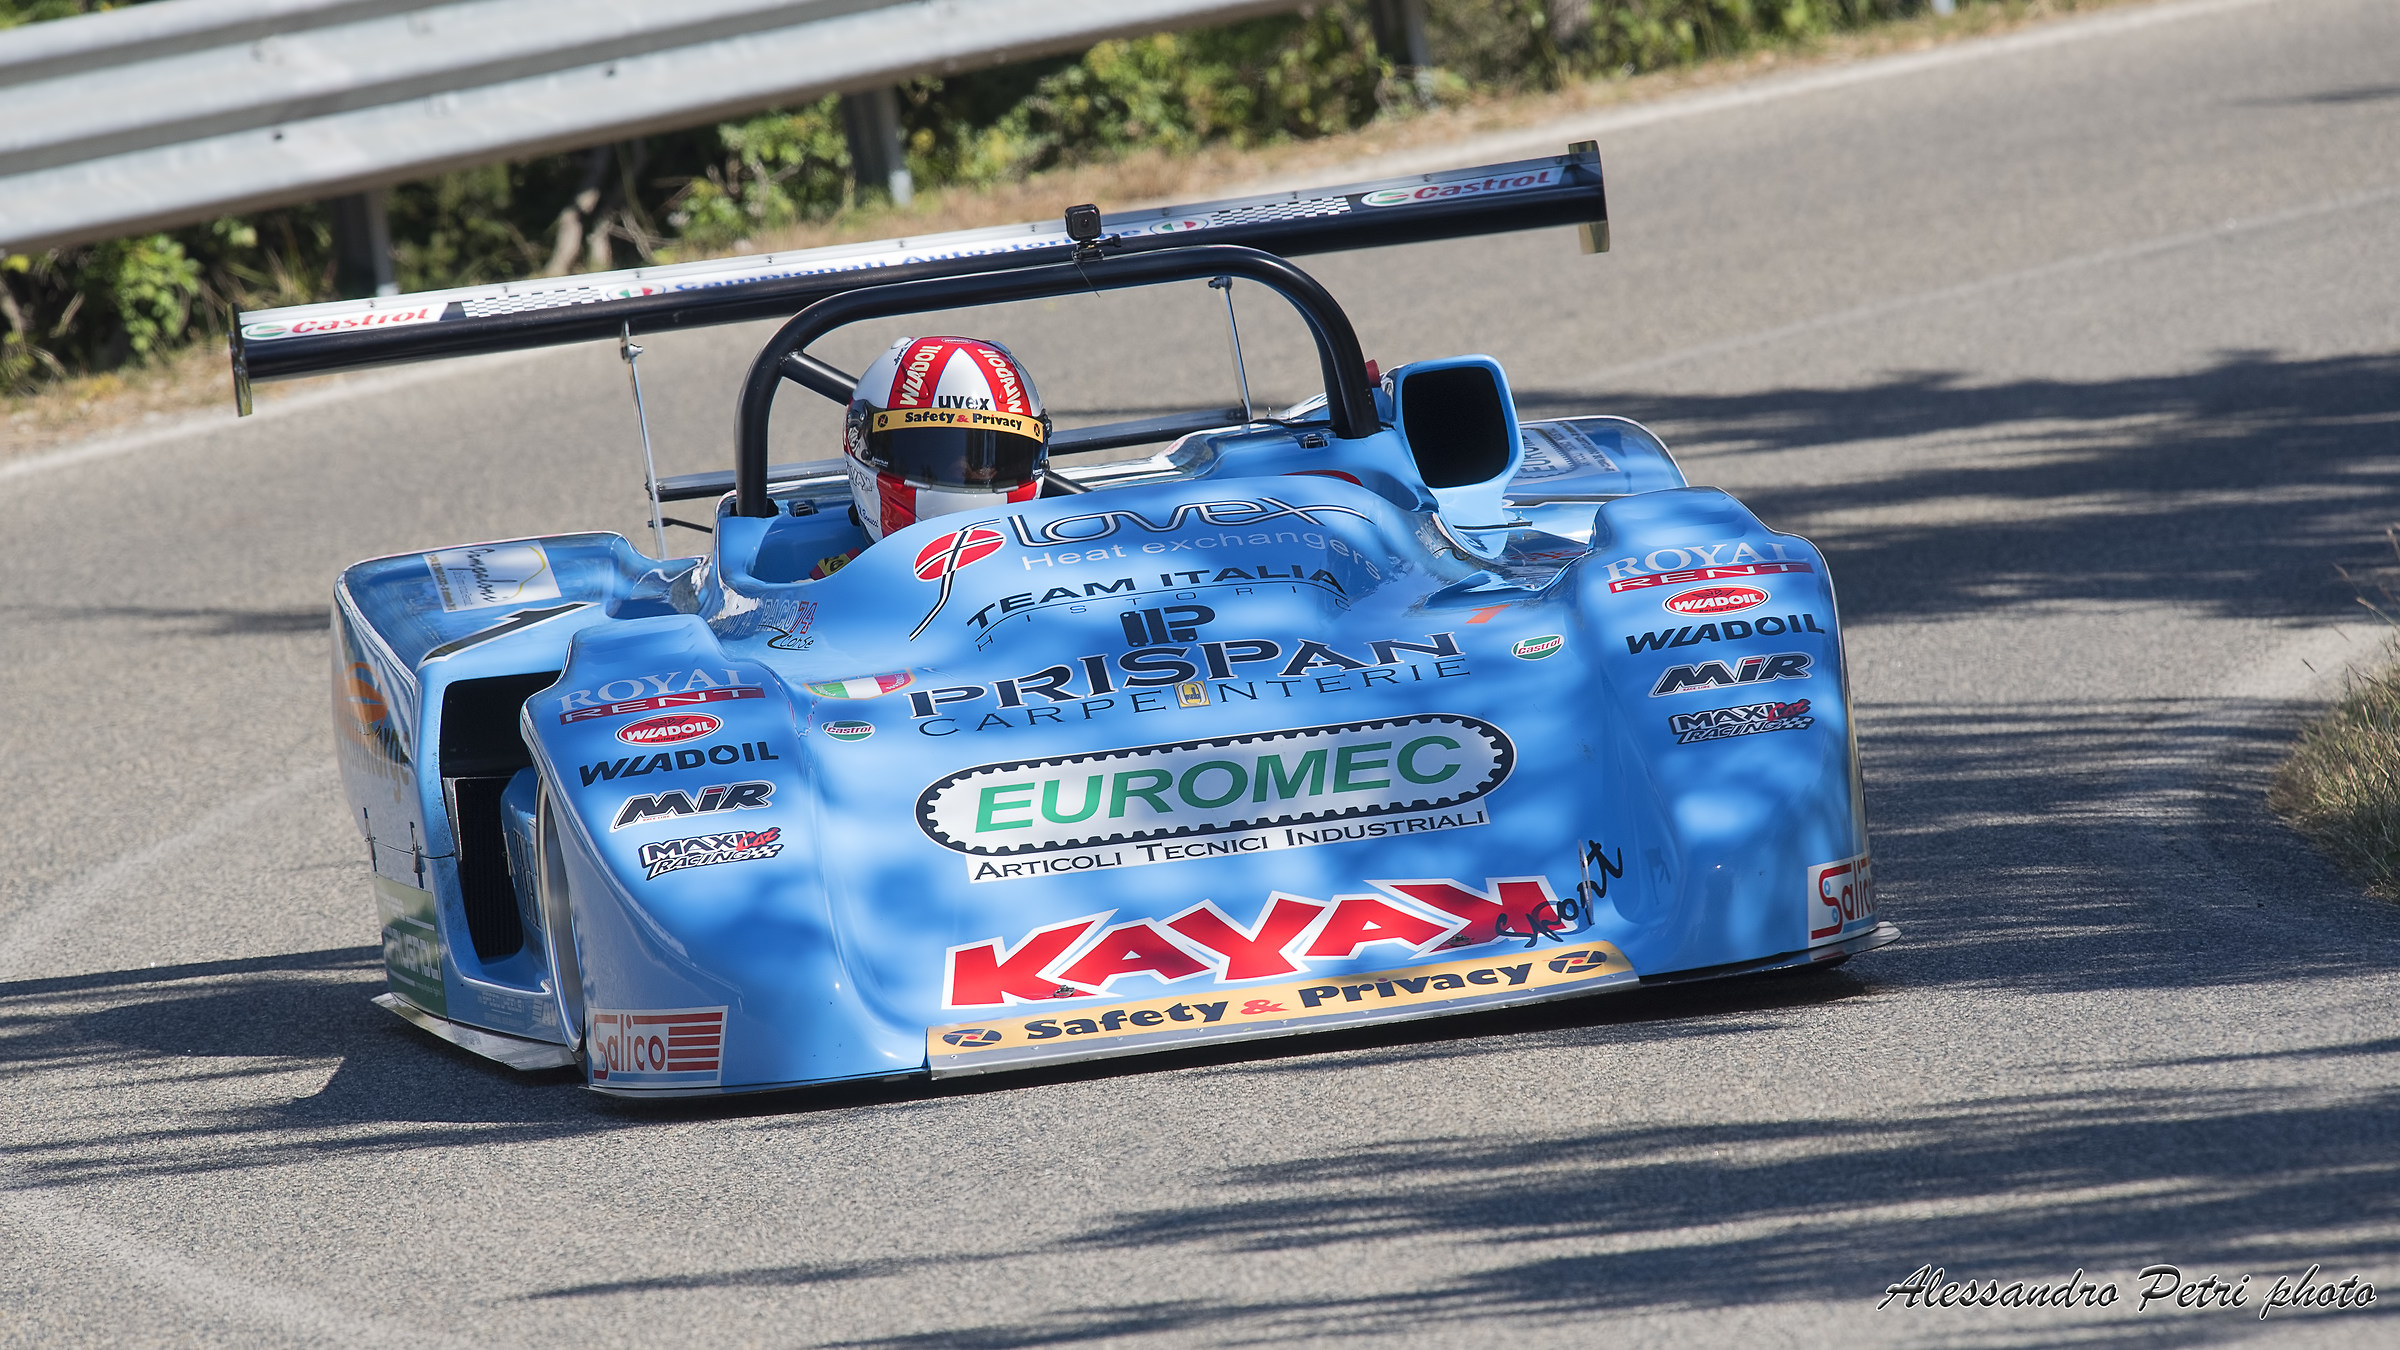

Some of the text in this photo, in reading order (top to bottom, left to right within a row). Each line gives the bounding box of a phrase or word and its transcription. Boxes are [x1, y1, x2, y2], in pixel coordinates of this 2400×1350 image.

[1413, 170, 1551, 200] Castrol
[902, 228, 1141, 266] Autostorihe
[291, 306, 430, 335] Castrol
[899, 345, 943, 406] WLADOIL
[904, 411, 1023, 431] Safety & Privacy
[938, 395, 990, 411] uvex
[1021, 545, 1128, 572] Heat
[1141, 528, 1381, 580] exchangers
[1601, 541, 1809, 583] ROYAL
[1613, 563, 1804, 592] RENT
[966, 563, 1348, 630] TEAM ITALIA
[1673, 593, 1761, 611] WLADOIL
[1517, 636, 1562, 655] Castrol
[1625, 613, 1826, 655] WLADOIL
[557, 668, 763, 714] ROYAL
[905, 630, 1466, 721] PRISPAN
[564, 687, 760, 723] RENT
[1669, 702, 1778, 735] MAXI
[626, 721, 713, 741] WLADOIL
[826, 725, 873, 735] Castrol
[1677, 720, 1784, 744] RACING
[578, 741, 779, 788] WLADOIL
[973, 734, 1463, 834] EUROMEC
[642, 831, 746, 868] MAXI
[646, 850, 752, 880] RACING
[1811, 856, 1877, 941] Salic
[944, 877, 1572, 1008] KAYAK
[1024, 961, 1535, 1042] Safety & Privacy
[593, 1013, 666, 1081] Salico
